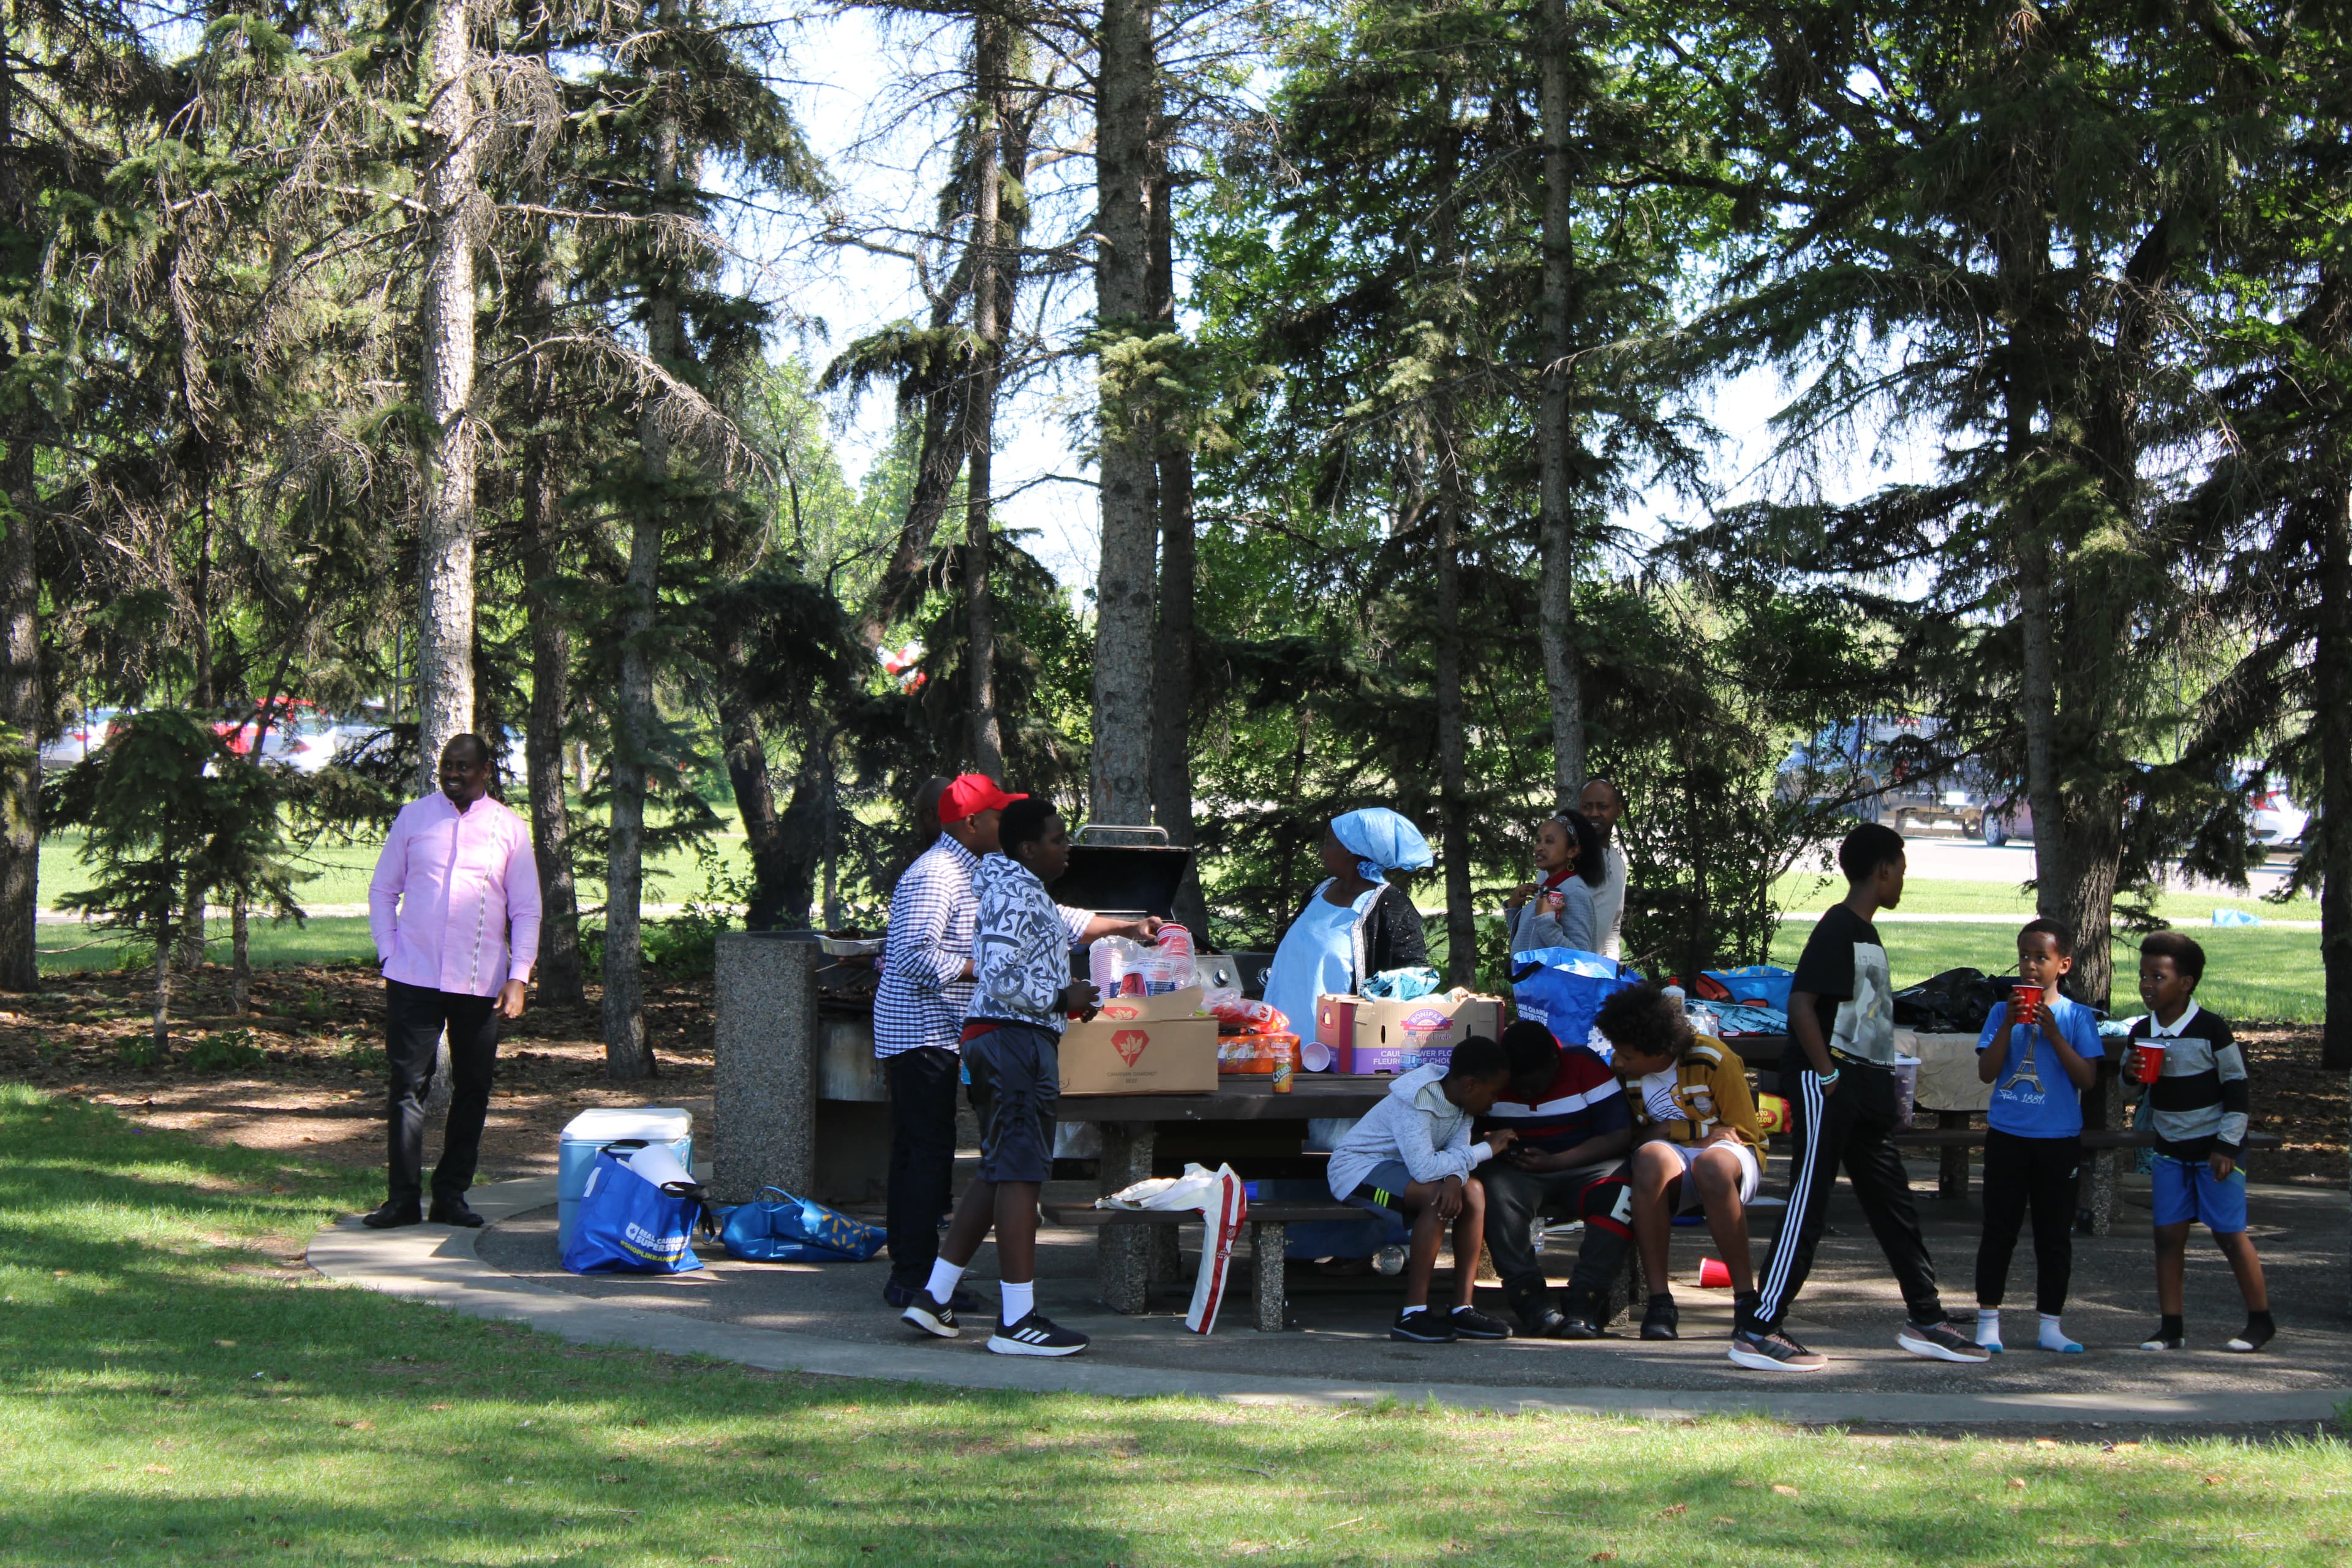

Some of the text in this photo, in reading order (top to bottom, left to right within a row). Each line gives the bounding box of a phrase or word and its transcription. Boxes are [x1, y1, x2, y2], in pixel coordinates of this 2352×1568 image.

[1272, 1064, 1291, 1084] Crush
[1998, 1090, 2018, 1101] Paris
[638, 1229, 655, 1242] REAL
